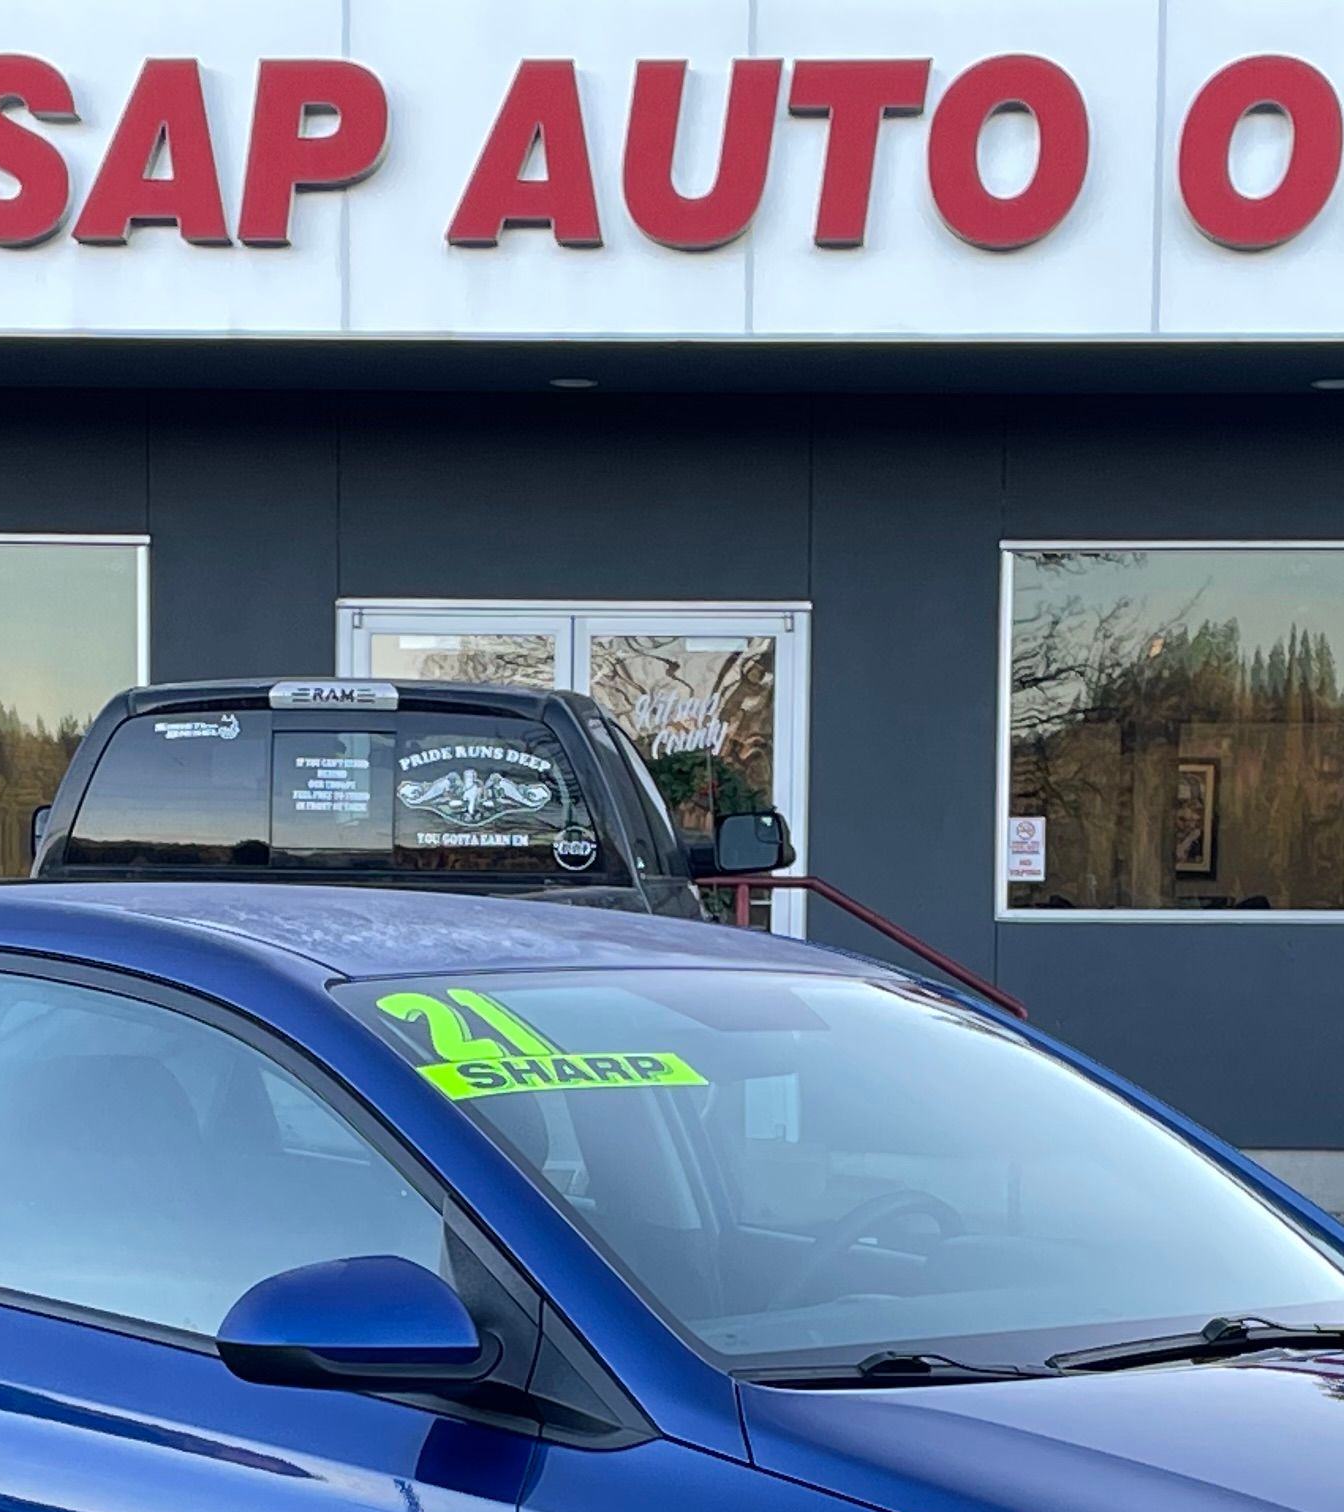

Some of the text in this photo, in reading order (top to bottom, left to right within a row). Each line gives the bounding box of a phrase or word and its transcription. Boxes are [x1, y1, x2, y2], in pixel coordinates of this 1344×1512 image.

[445, 52, 1092, 253] AUTO
[312, 687, 355, 703] RAM
[399, 745, 551, 772] PRIDE RUNS DEEP
[417, 833, 440, 845] YOU
[442, 833, 479, 846] GOTTA
[376, 988, 555, 1062] 21
[456, 1055, 674, 1089] SHARP
